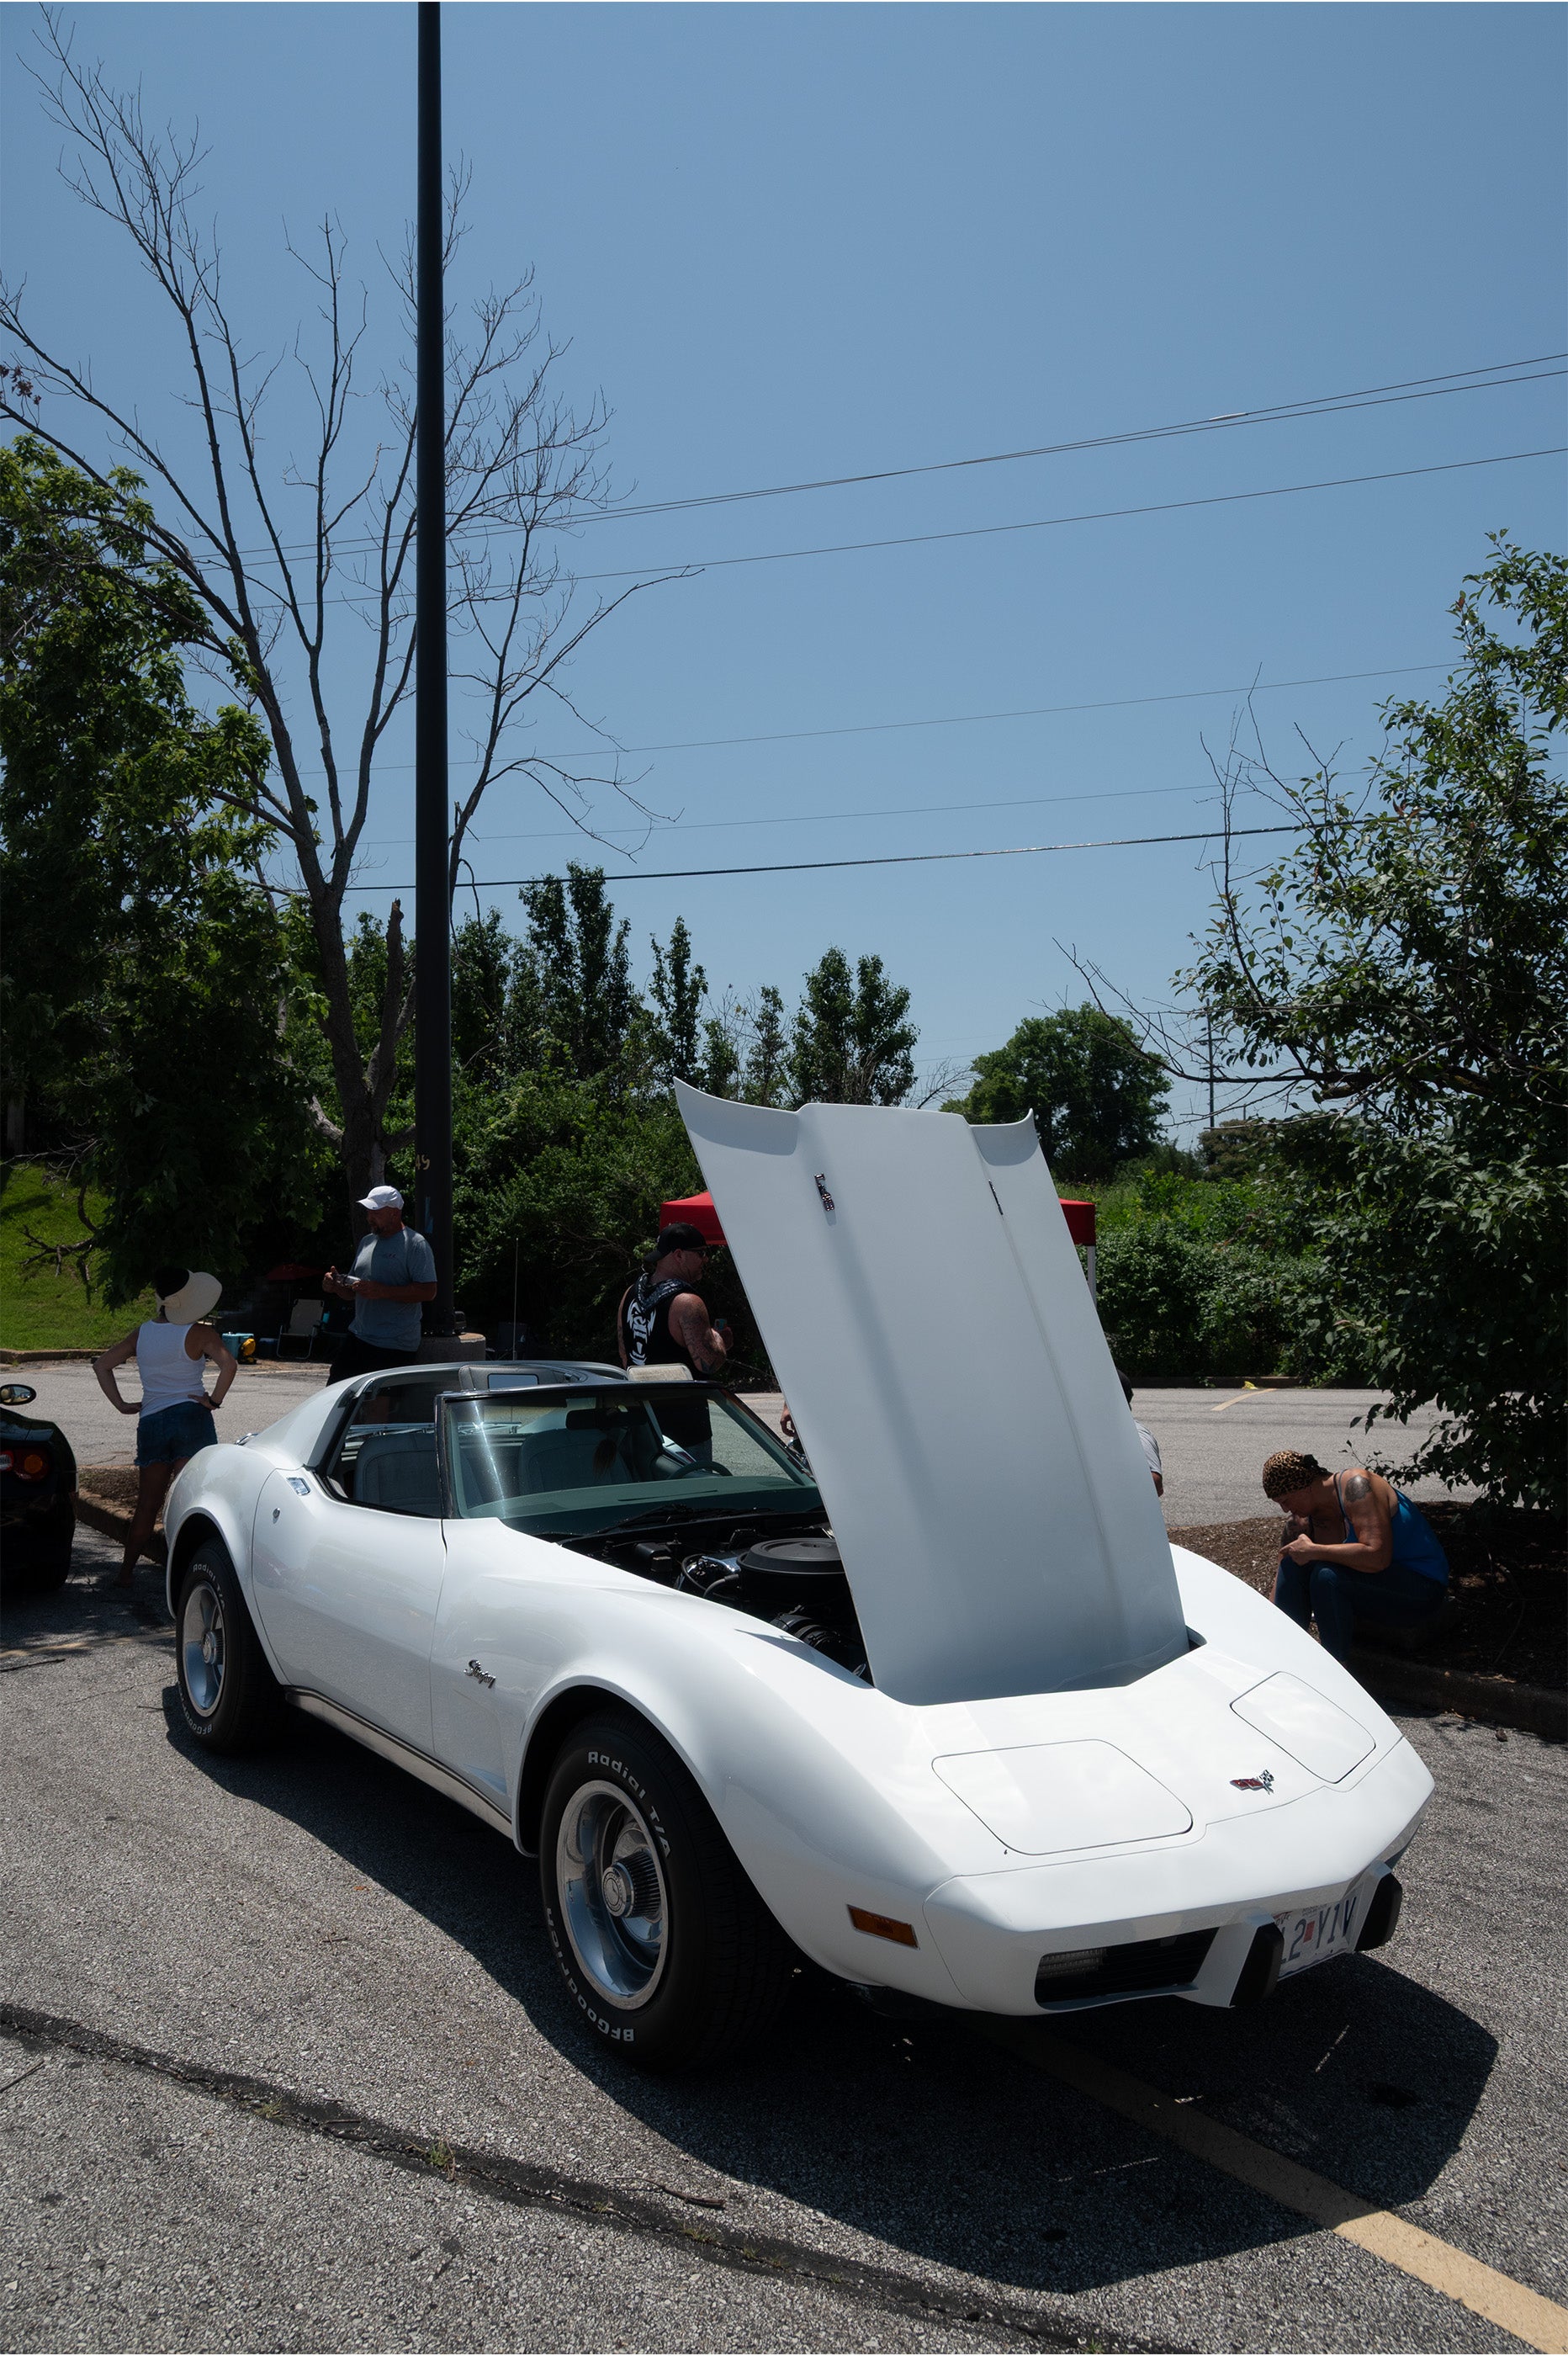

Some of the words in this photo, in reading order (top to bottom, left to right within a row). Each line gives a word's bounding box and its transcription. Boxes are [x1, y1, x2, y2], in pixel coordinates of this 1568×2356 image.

[192, 1563, 216, 1582] Radial
[588, 1751, 647, 1799] Radial
[650, 1805, 671, 1859] T/A
[546, 1907, 635, 2042] BFGoodrich
